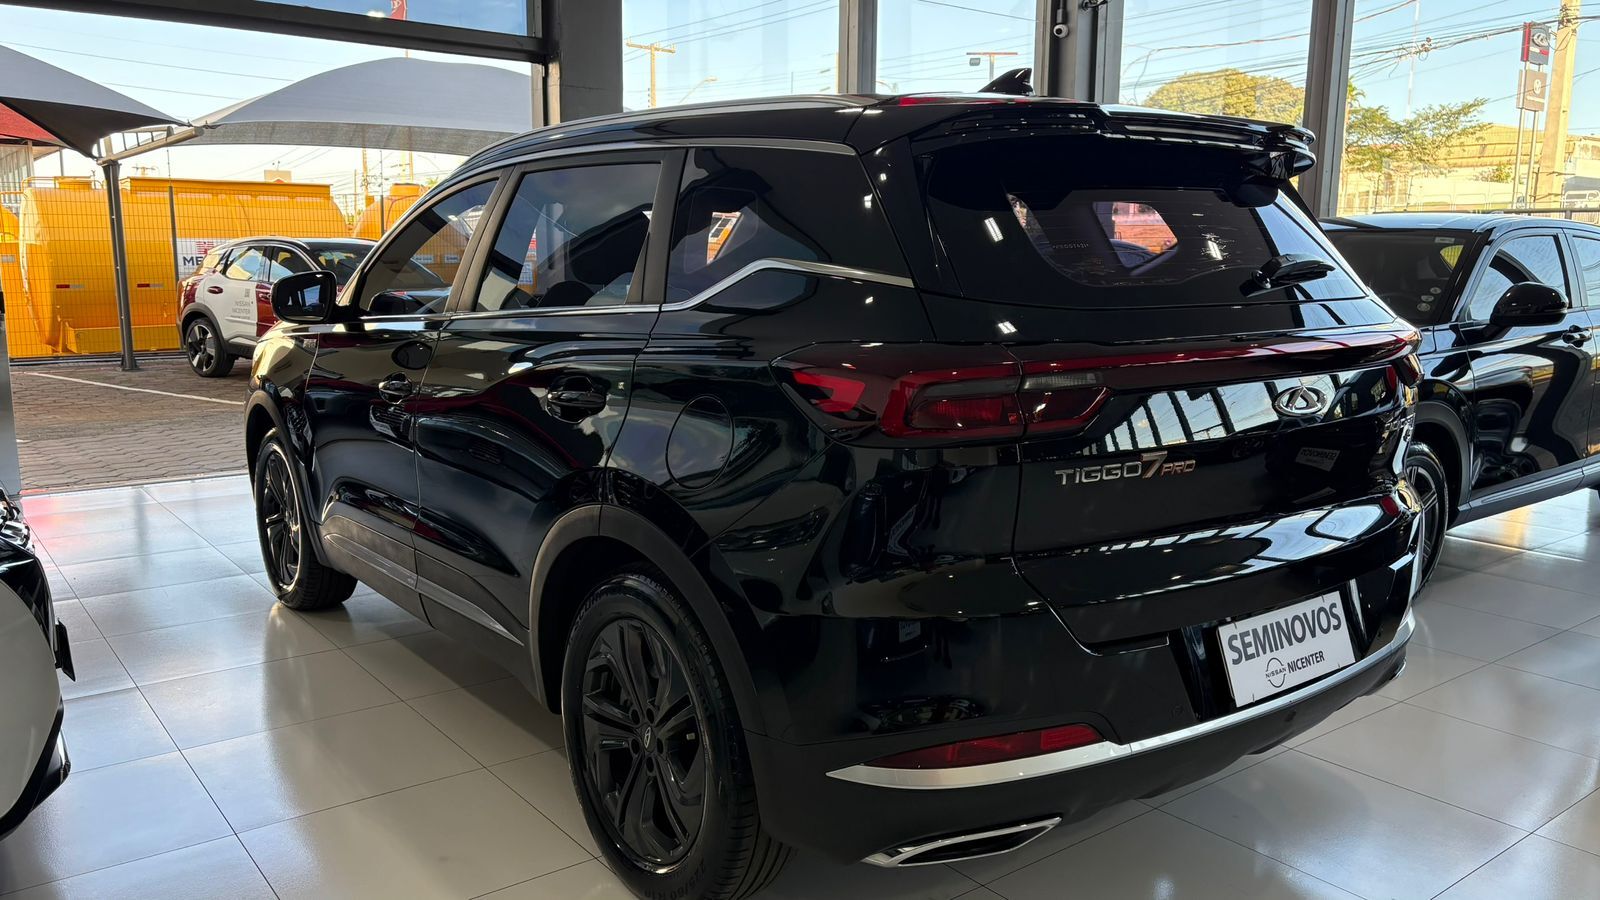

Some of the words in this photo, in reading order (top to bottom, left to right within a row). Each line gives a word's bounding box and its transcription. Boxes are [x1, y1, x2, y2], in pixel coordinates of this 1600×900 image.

[1055, 461, 1142, 485] TIGGO
[1140, 450, 1168, 479] 7
[1160, 460, 1196, 476] PRO
[1227, 602, 1342, 665] SEMINOVOS
[1265, 667, 1287, 678] NISSAN
[1287, 650, 1325, 674] NICENTER
